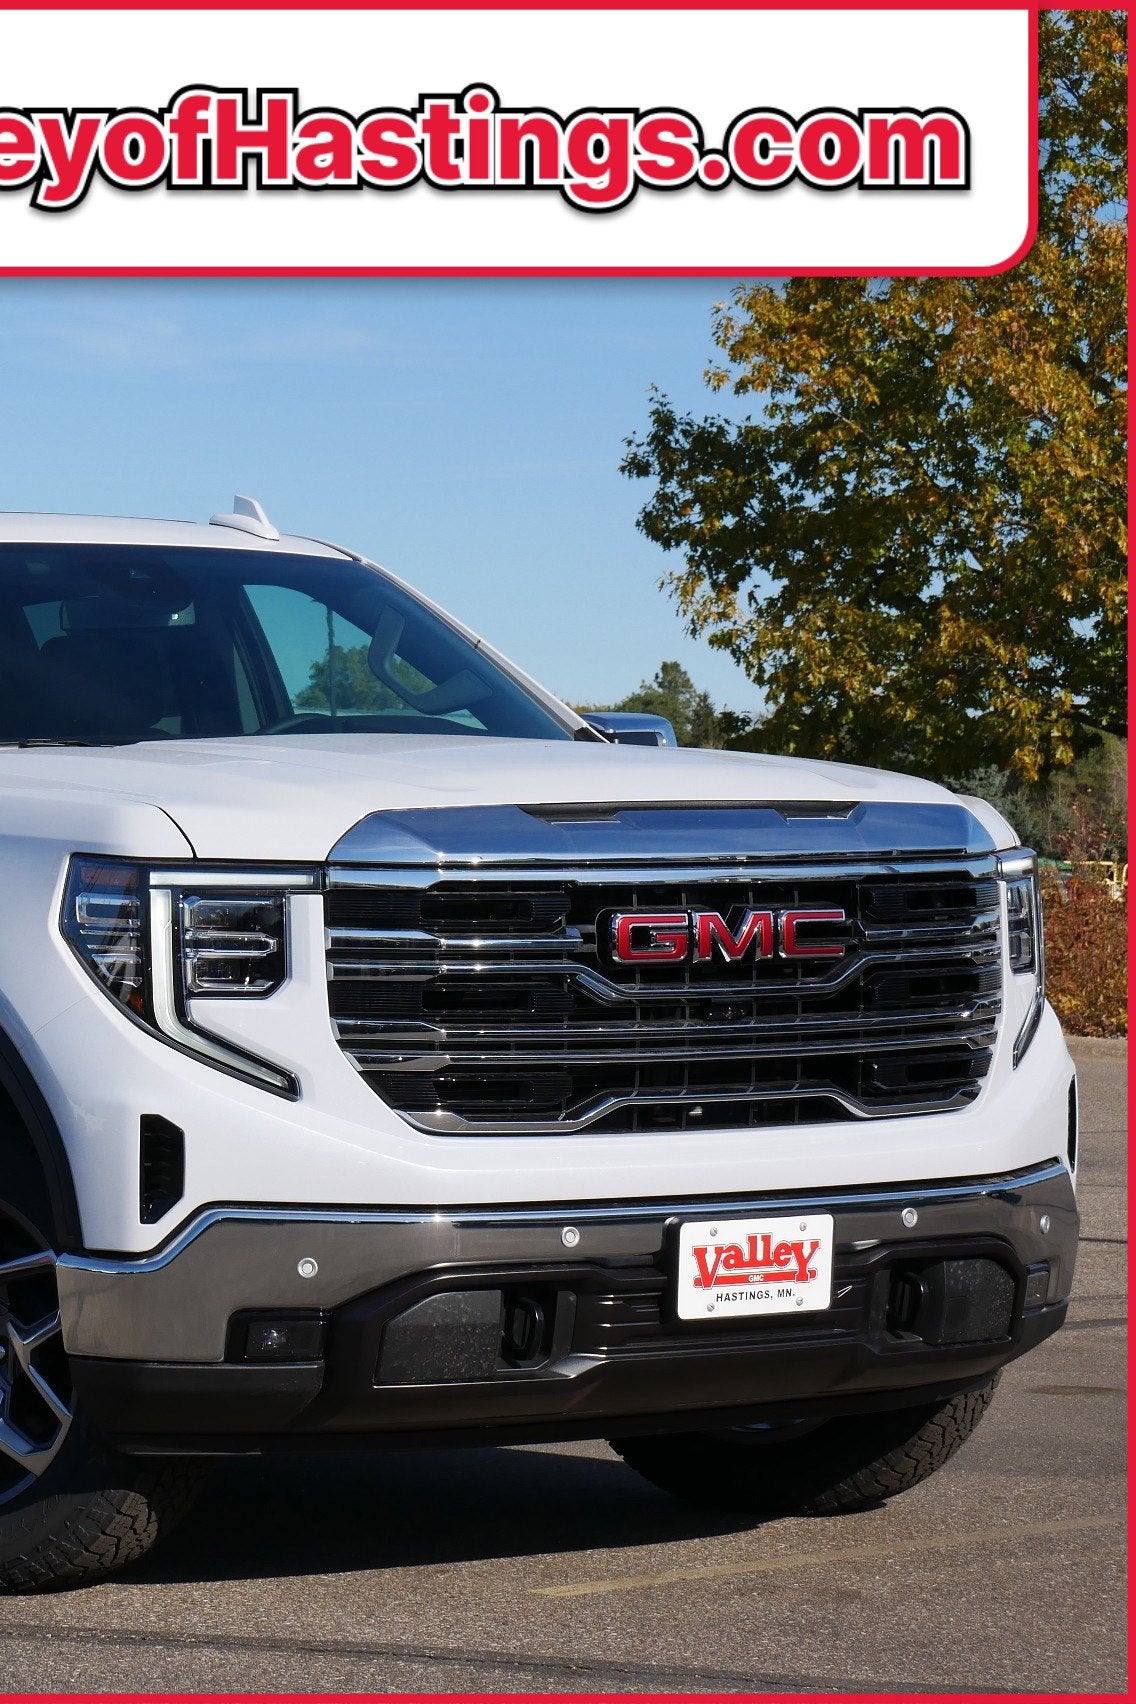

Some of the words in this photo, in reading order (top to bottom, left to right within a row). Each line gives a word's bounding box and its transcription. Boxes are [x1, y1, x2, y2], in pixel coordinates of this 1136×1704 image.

[612, 909, 845, 962] GMC
[692, 1232, 820, 1290] Valley
[748, 1274, 764, 1282] GMC
[716, 1289, 773, 1302] HASTINGS,
[777, 1288, 795, 1298] MN.
